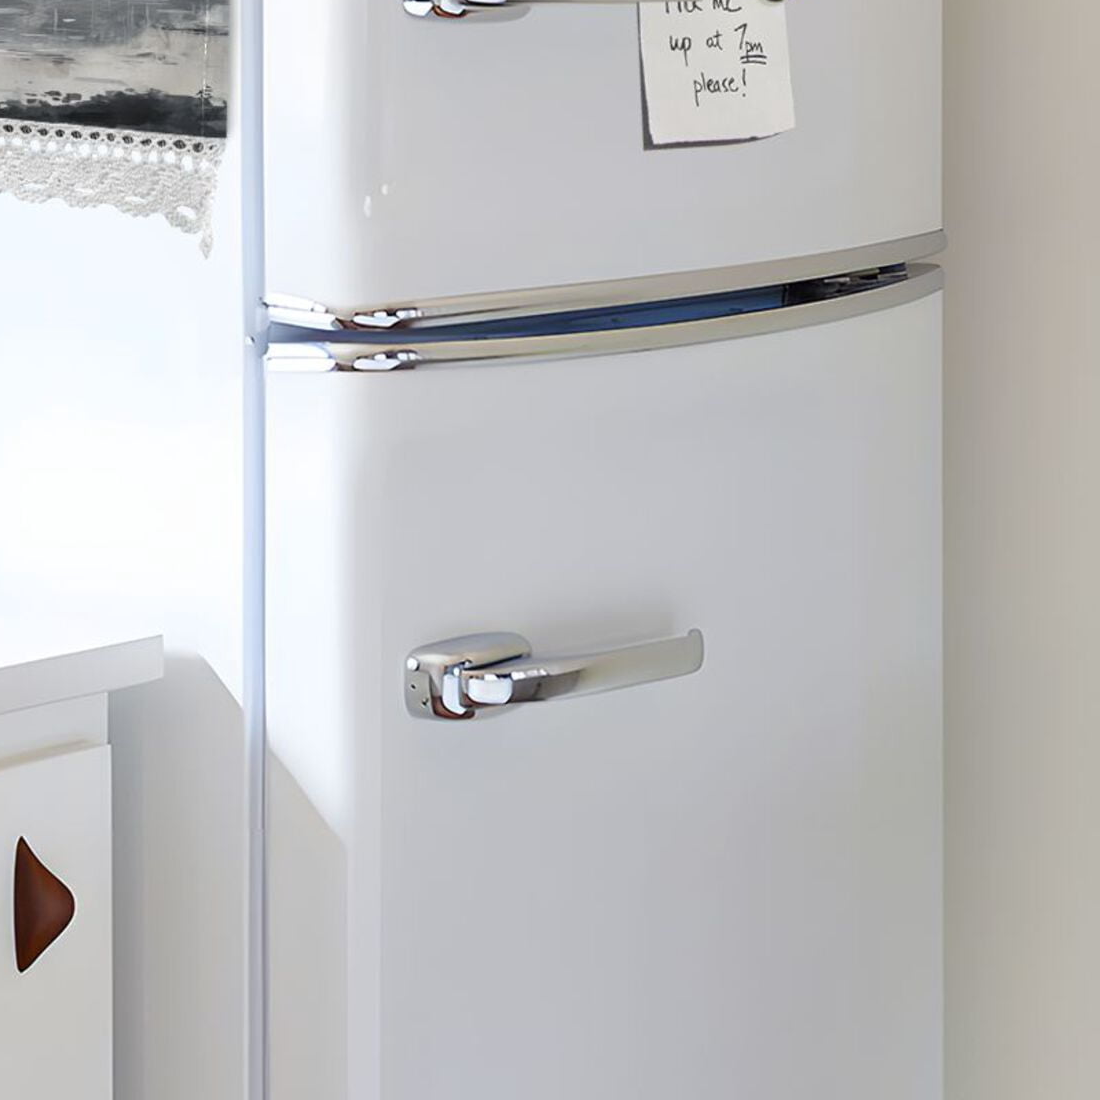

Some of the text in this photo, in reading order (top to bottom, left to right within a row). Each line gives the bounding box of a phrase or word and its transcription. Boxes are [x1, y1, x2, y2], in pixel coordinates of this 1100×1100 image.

[669, 35, 692, 66] up
[706, 30, 723, 50] at
[693, 68, 746, 107] please!
